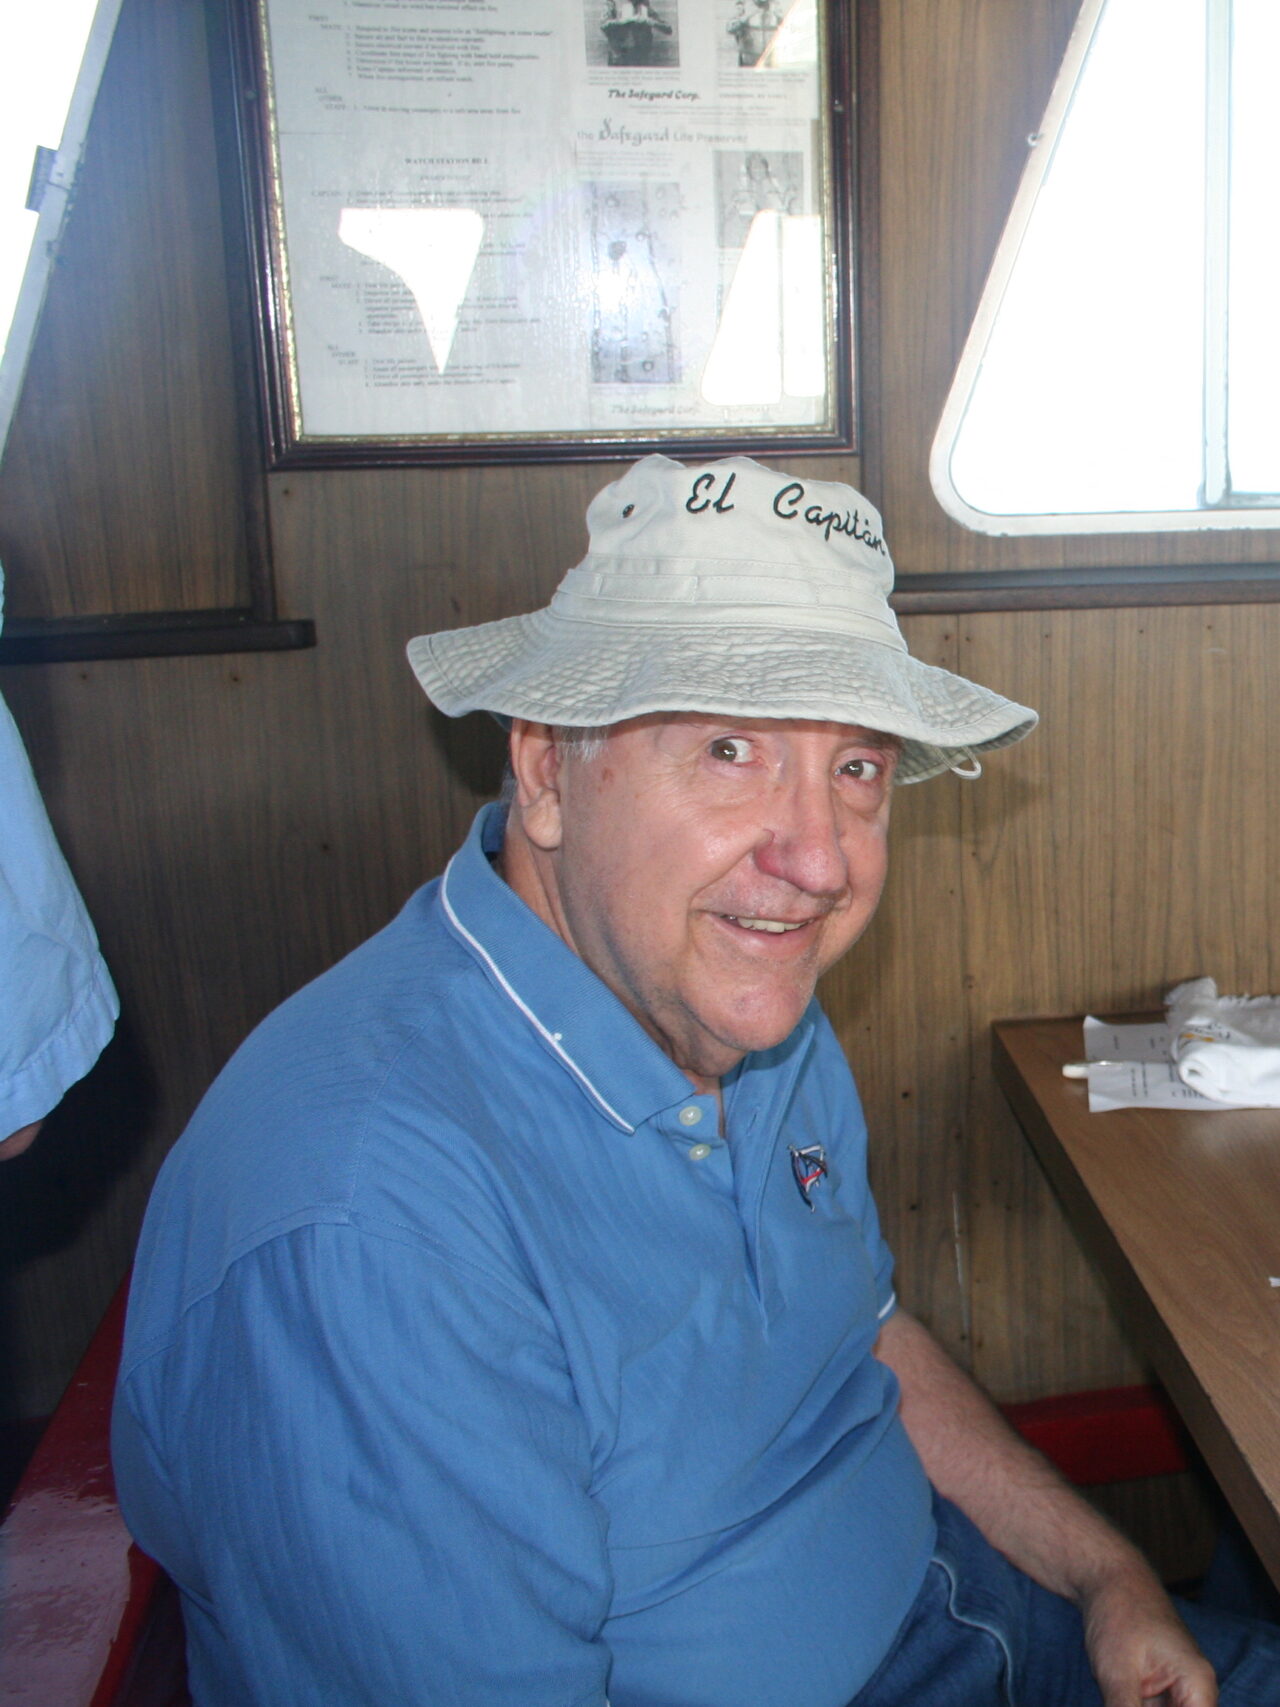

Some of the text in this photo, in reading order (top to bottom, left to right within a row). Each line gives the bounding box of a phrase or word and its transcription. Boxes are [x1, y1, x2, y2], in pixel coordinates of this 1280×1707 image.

[607, 89, 701, 101] The Safegard Corp.
[577, 129, 594, 140] the
[598, 117, 669, 146] Safegard
[685, 472, 736, 515] El
